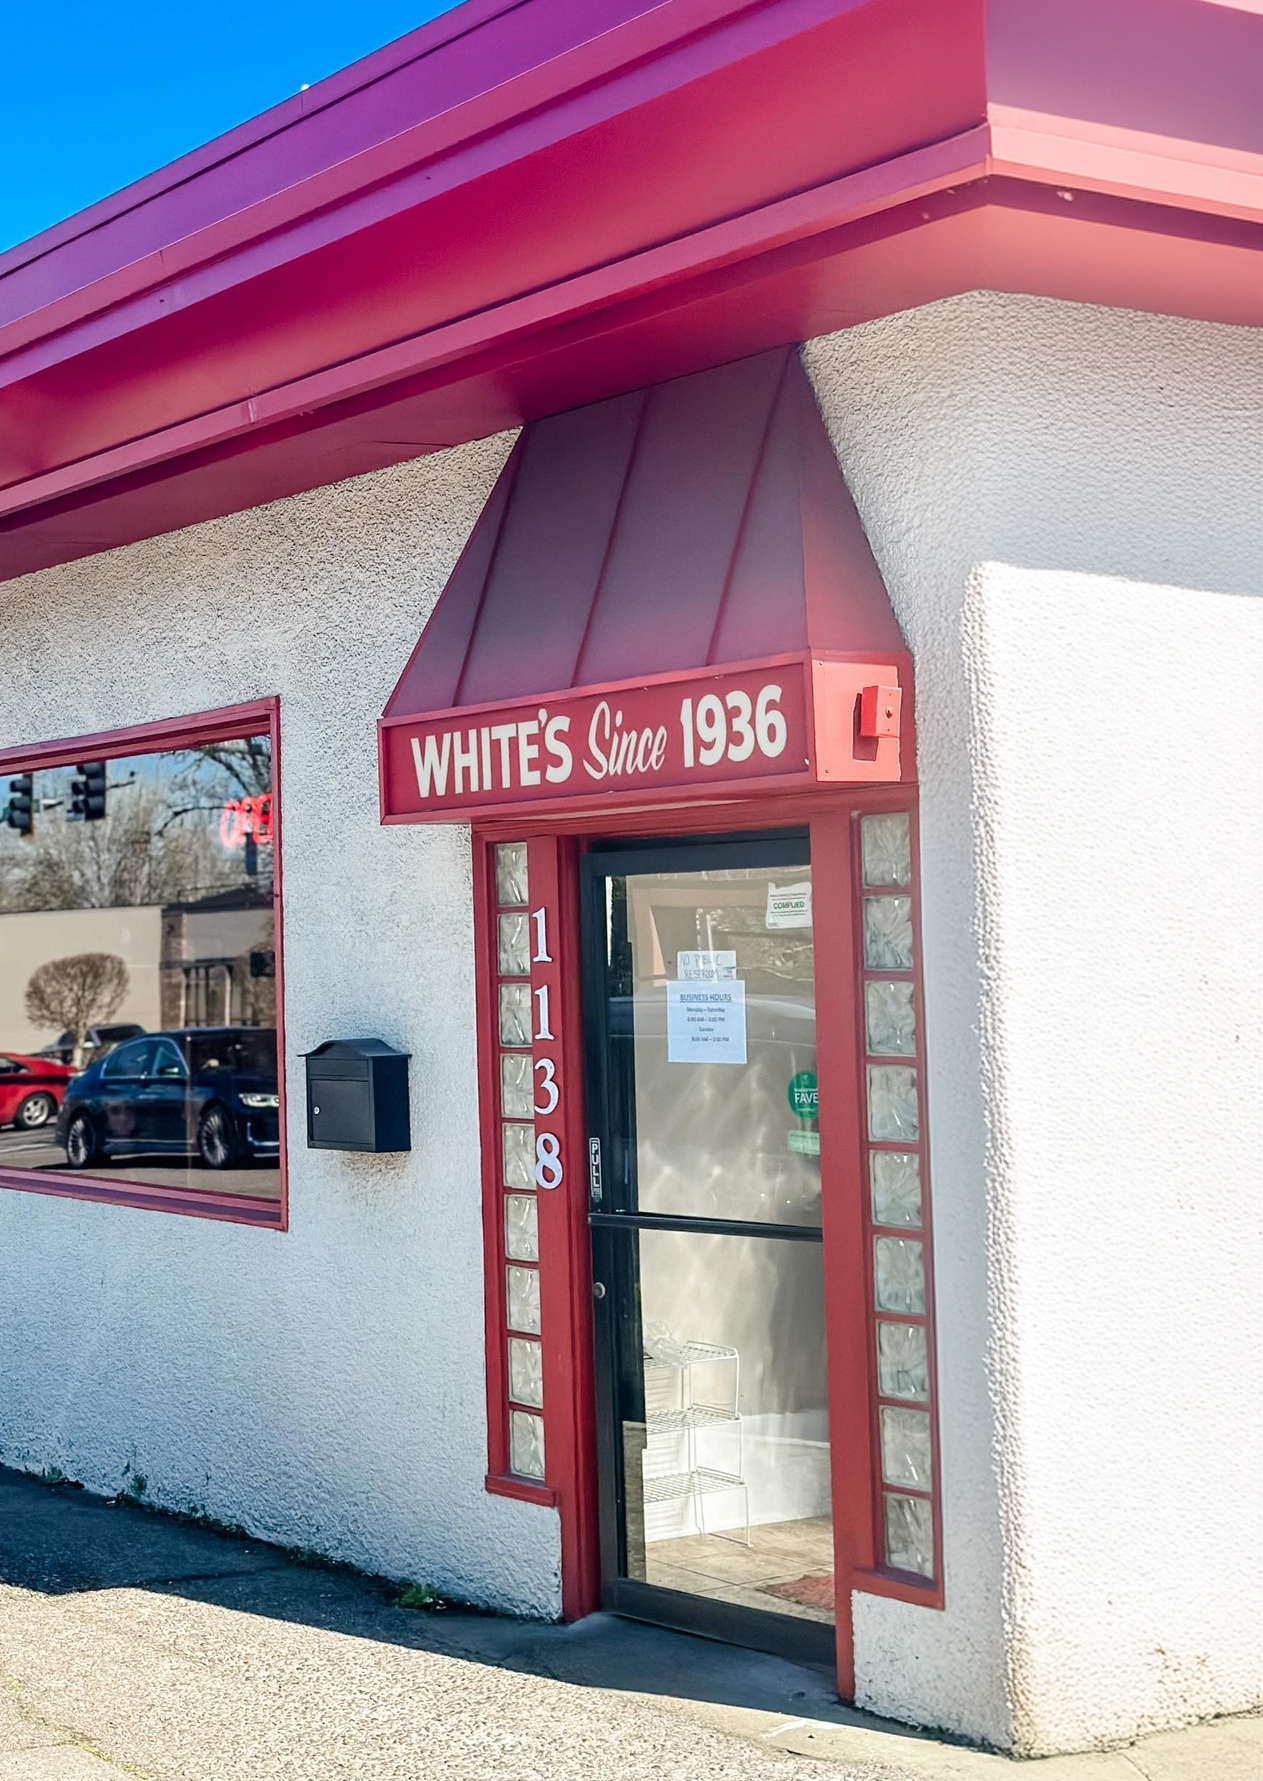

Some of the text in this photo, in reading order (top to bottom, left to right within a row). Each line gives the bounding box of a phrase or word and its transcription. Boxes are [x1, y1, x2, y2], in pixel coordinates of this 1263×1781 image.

[411, 684, 788, 799] WHITE'S Since 1936
[220, 793, 273, 848] OPE
[694, 953, 722, 966] PBLC
[679, 993, 732, 1002] BUSINESS HOURS
[532, 906, 564, 1190] 1138
[794, 1092, 819, 1104] FAVE
[591, 1143, 600, 1188] PULL
